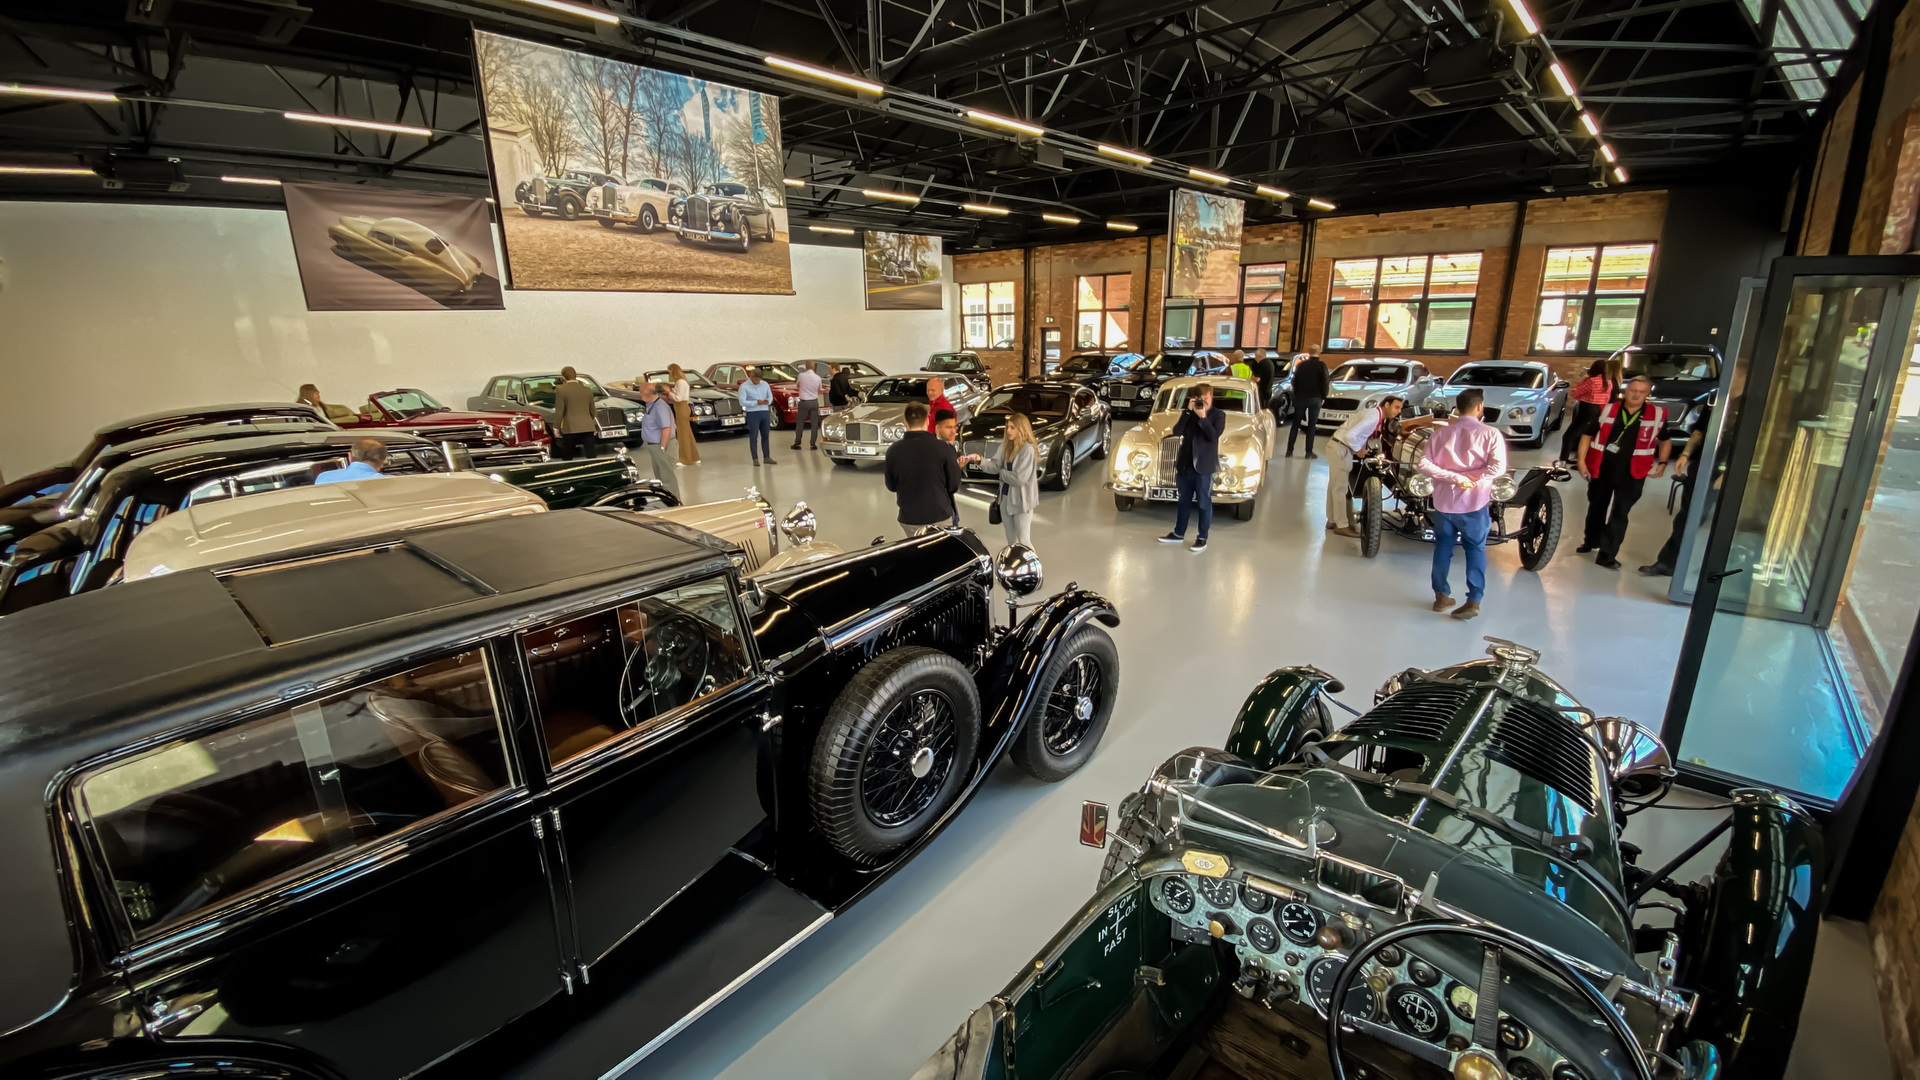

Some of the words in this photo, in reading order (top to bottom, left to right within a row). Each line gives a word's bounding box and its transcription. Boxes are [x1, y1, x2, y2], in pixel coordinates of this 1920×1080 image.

[1153, 489, 1174, 499] JAS
[1107, 893, 1133, 918] SLOW
[1097, 926, 1108, 943] IN
[1104, 927, 1127, 957] FAST
